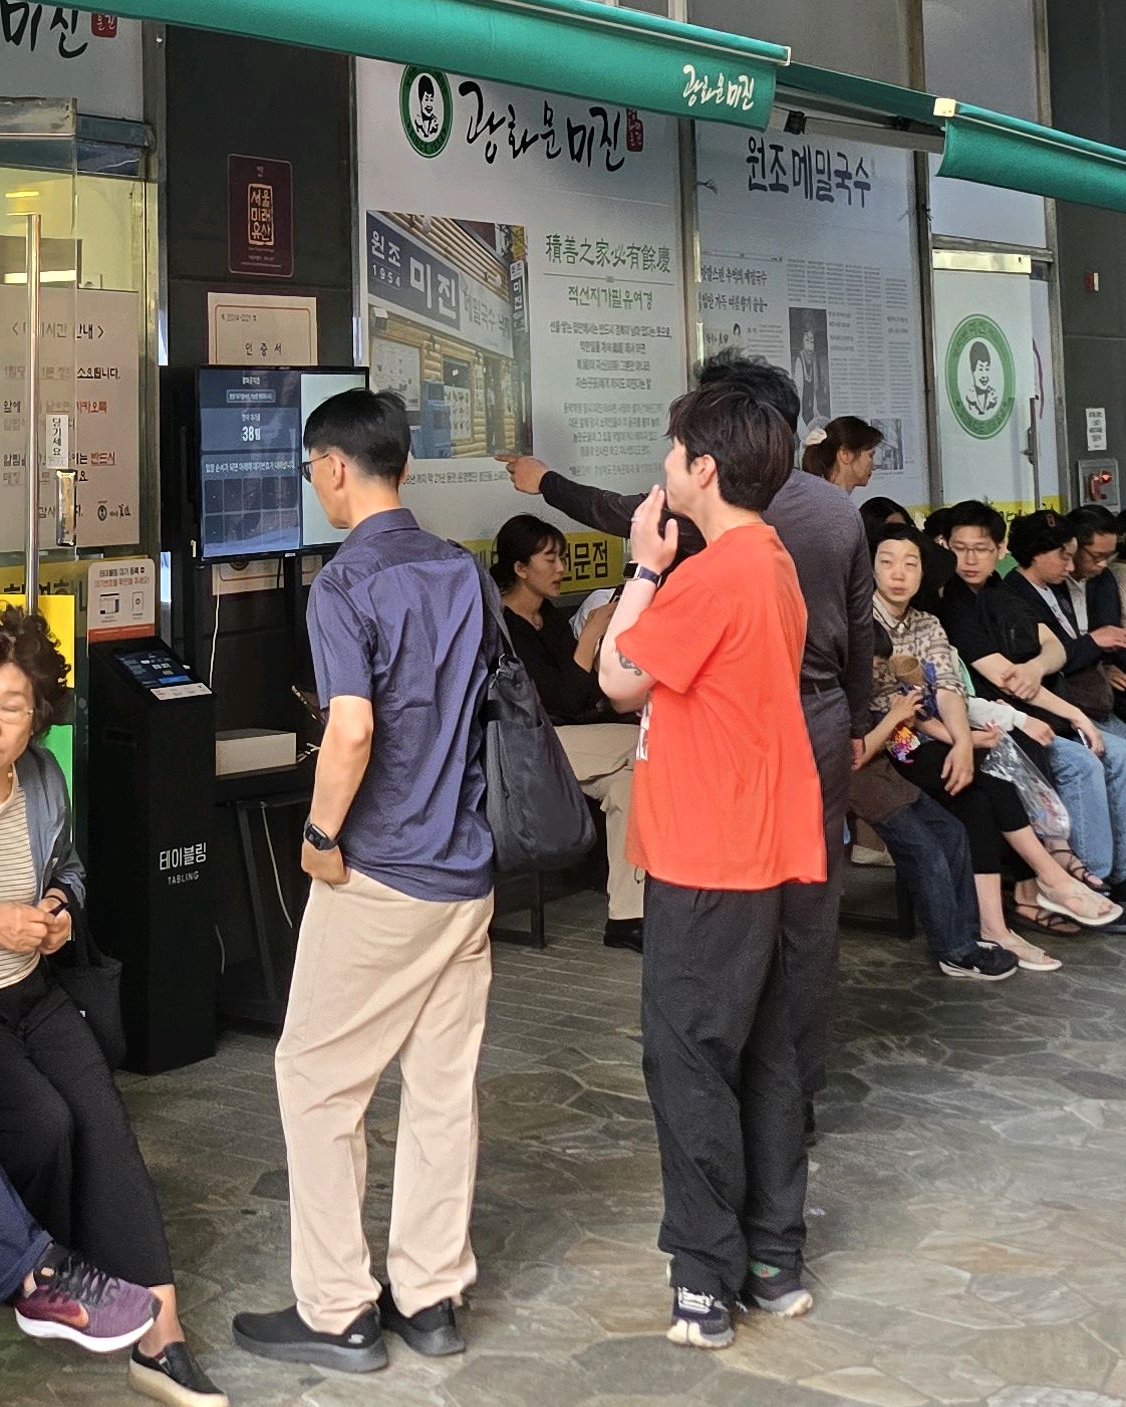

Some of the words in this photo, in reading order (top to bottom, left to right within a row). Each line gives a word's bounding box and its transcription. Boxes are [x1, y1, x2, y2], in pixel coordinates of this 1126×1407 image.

[250, 189, 271, 208] 서울
[250, 207, 271, 222] 미래
[251, 222, 271, 241] 유산
[371, 230, 401, 268] 원조
[545, 234, 671, 273] 積善之家必有餘慶
[372, 264, 401, 287] 1954
[410, 256, 457, 319] 미진
[159, 842, 207, 871] 테이블링
[167, 870, 200, 885] TABLING
